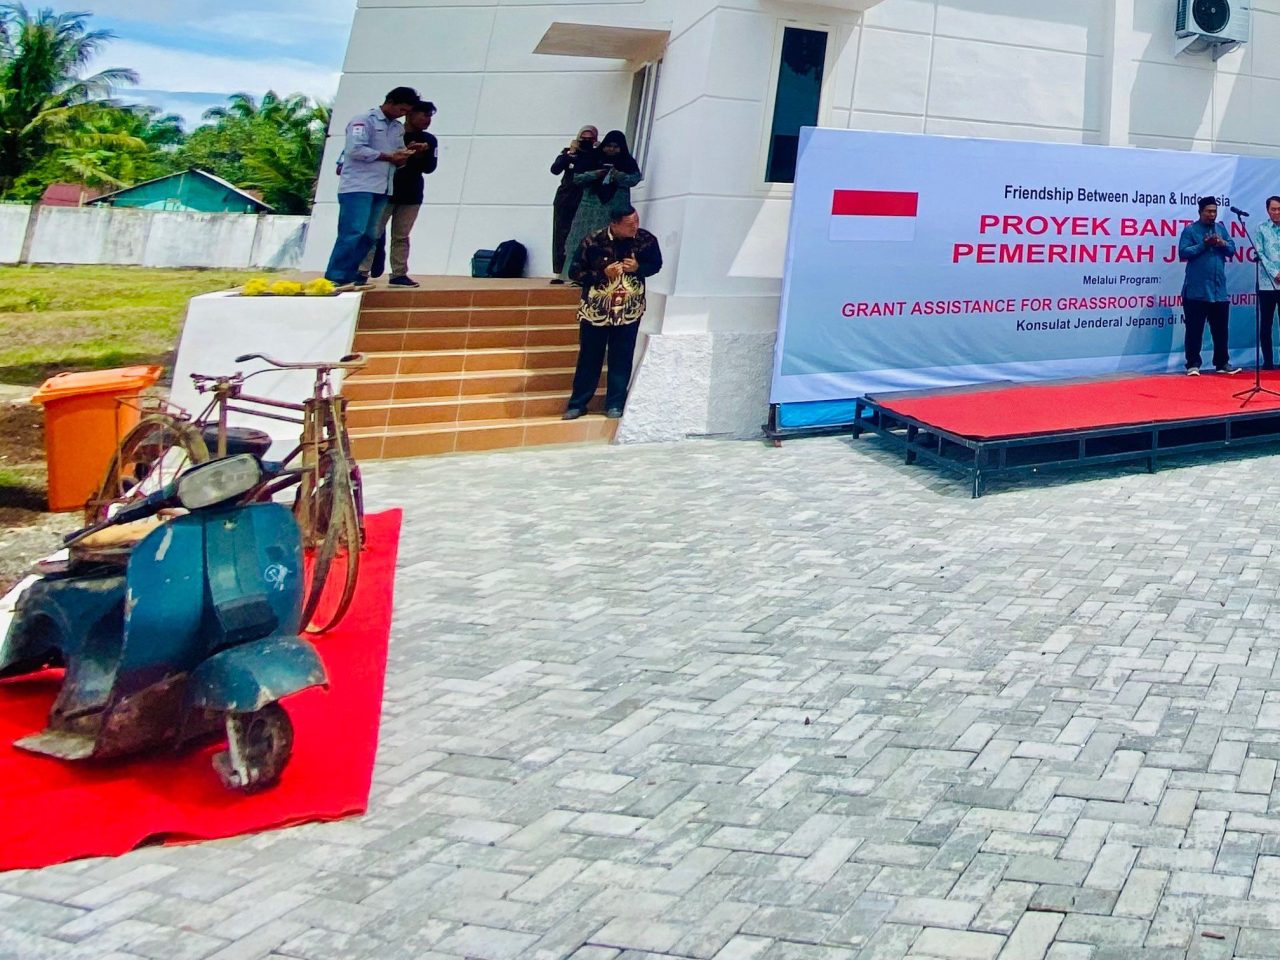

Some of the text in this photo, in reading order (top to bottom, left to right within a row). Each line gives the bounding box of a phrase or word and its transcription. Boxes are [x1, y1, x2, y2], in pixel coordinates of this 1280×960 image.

[1004, 185, 1074, 204] Friendship
[1077, 188, 1129, 203] Between
[1131, 190, 1166, 207] Japan
[1169, 192, 1178, 205] &
[979, 214, 1111, 236] PROYEK
[952, 243, 1154, 264] PEMERINTAH
[1083, 275, 1162, 286] Melalui Program:
[842, 302, 907, 317] GRANT
[911, 299, 1016, 315] ASSISTANCE
[1021, 298, 1052, 311] FOR
[1057, 295, 1155, 310] GRASSROOTS
[1016, 319, 1071, 331] Konsulat
[1073, 316, 1123, 329] Jenderal
[1125, 315, 1165, 328] Jepang
[1168, 314, 1177, 325] di
